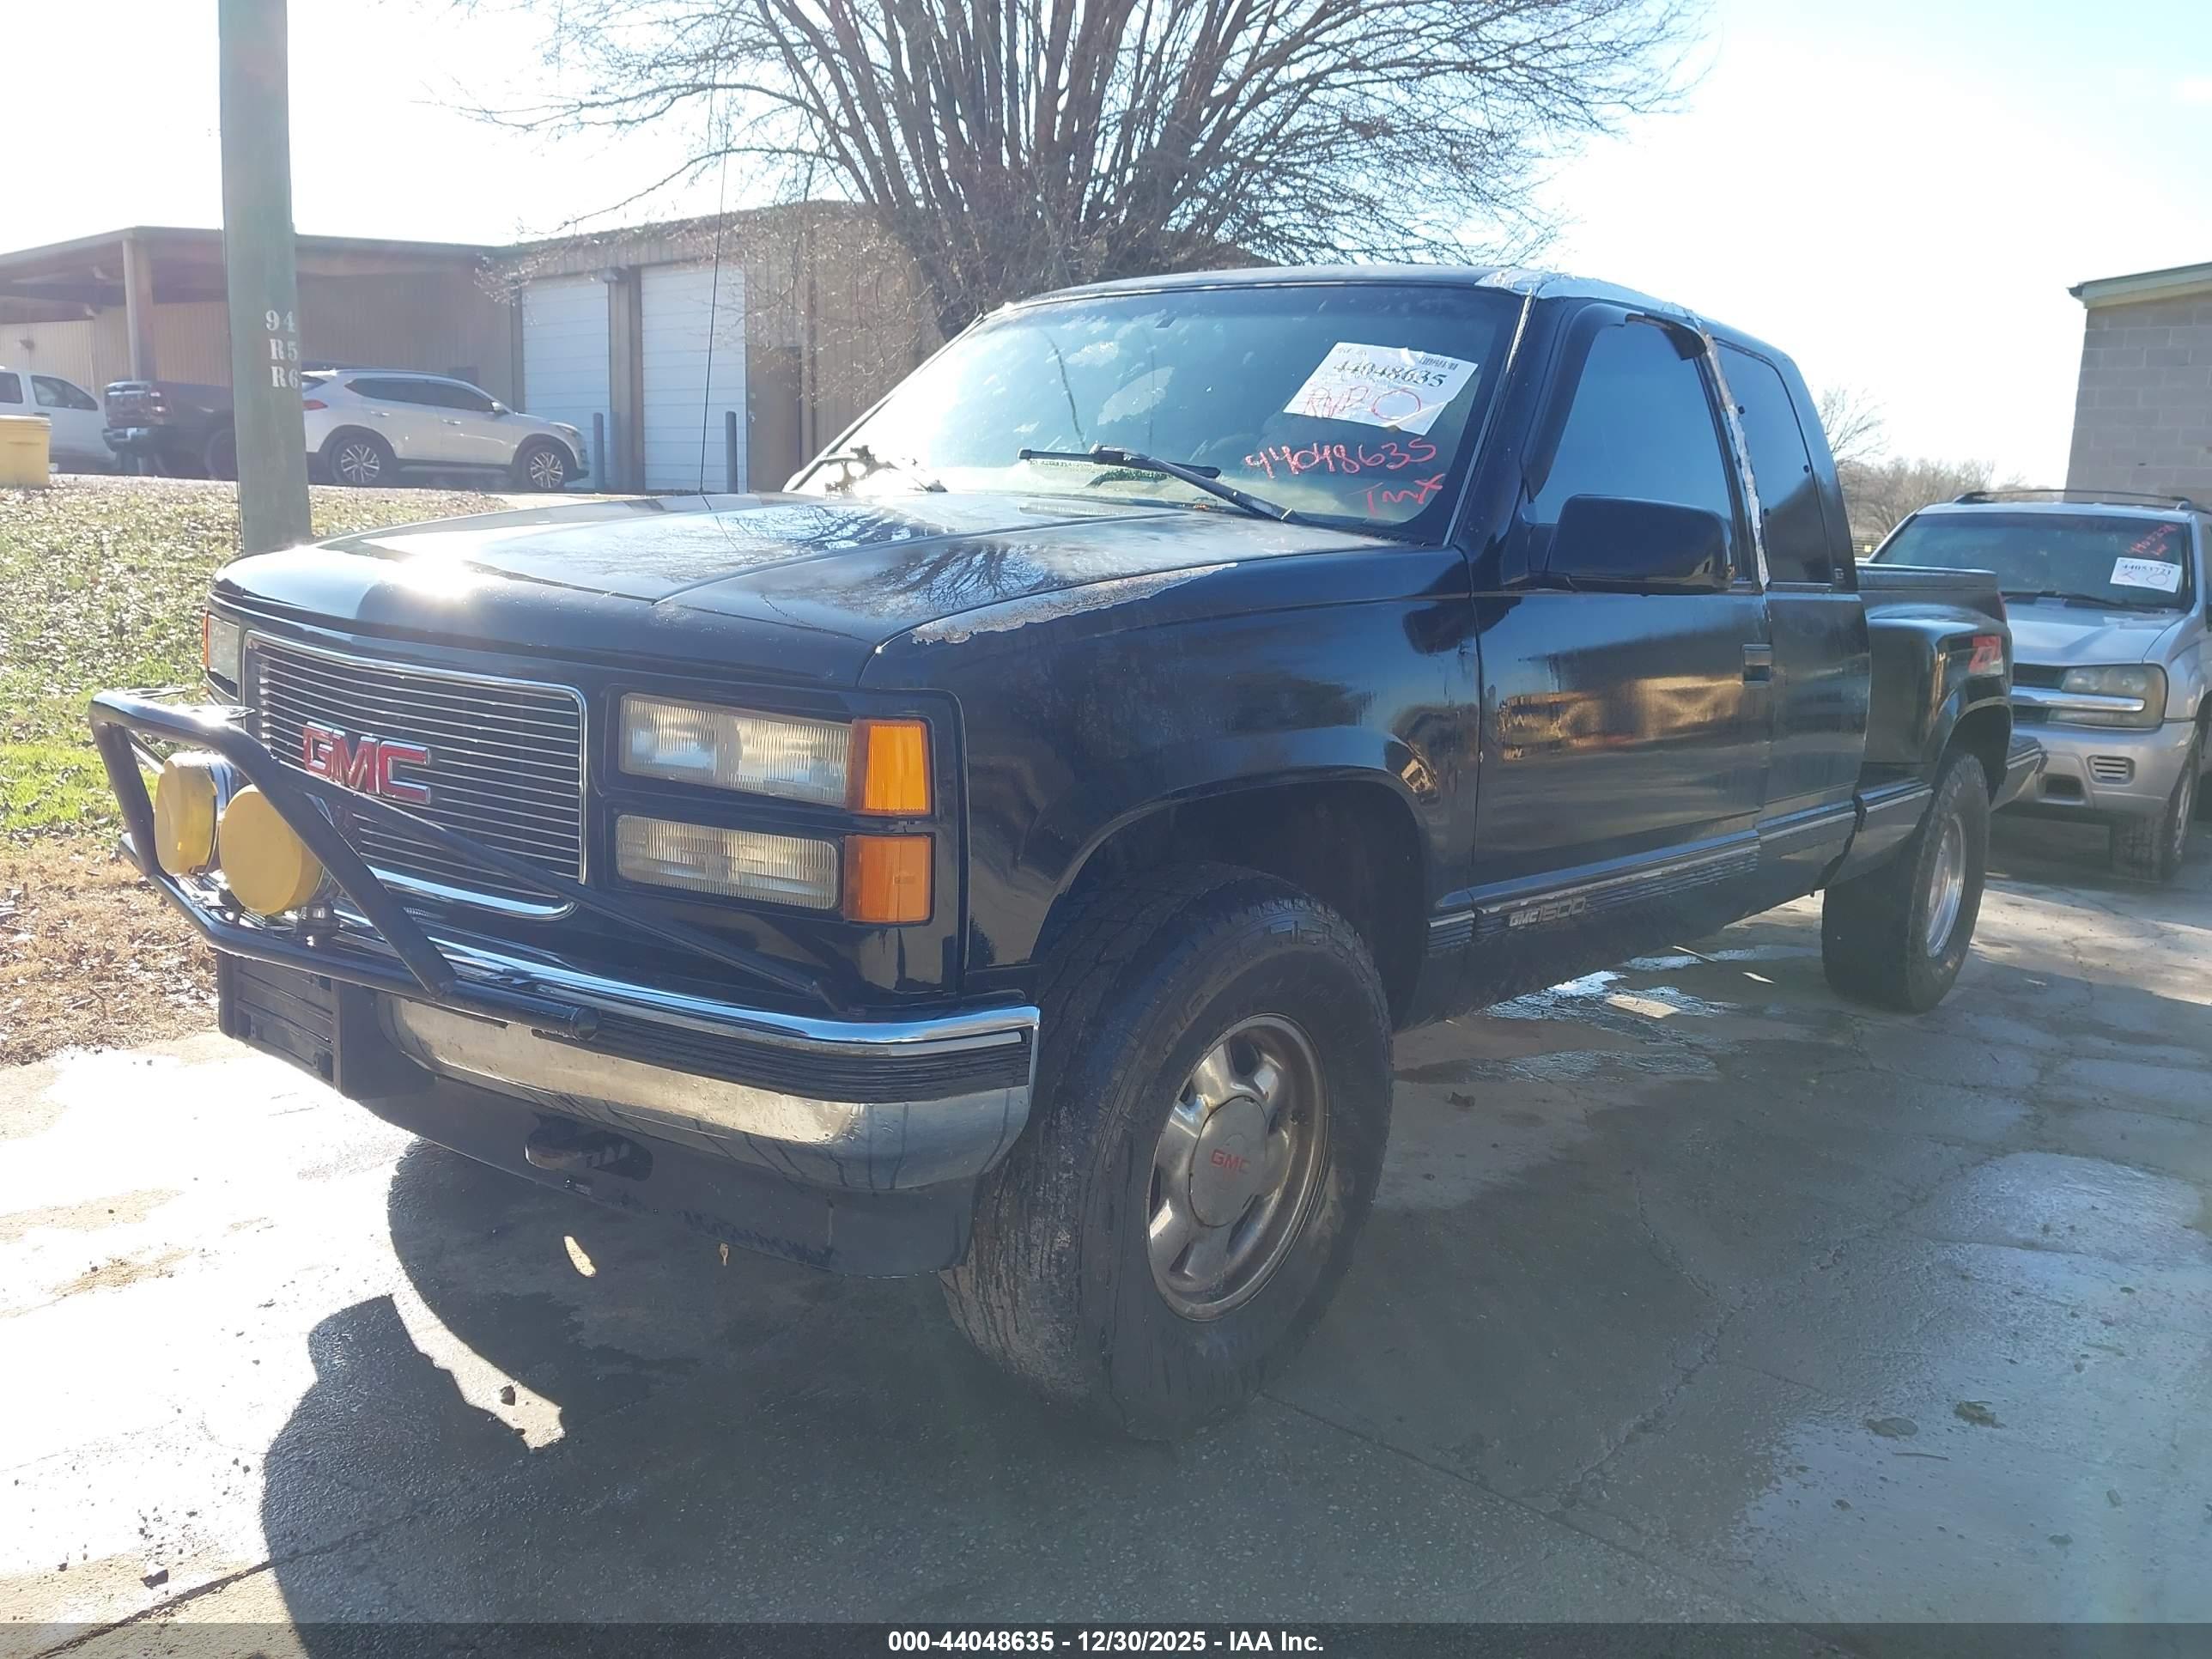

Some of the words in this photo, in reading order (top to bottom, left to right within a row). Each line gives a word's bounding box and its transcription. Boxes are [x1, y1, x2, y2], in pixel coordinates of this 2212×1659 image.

[265, 309, 295, 333] 94
[269, 337, 299, 362] R5
[270, 365, 300, 390] R6
[1333, 361, 1448, 387] 44048635
[1245, 438, 1437, 479] 44048635
[302, 720, 431, 805] GMC
[1509, 910, 1541, 927] GMC
[1538, 896, 1589, 923] 1500
[1211, 1148, 1250, 1175] GMC
